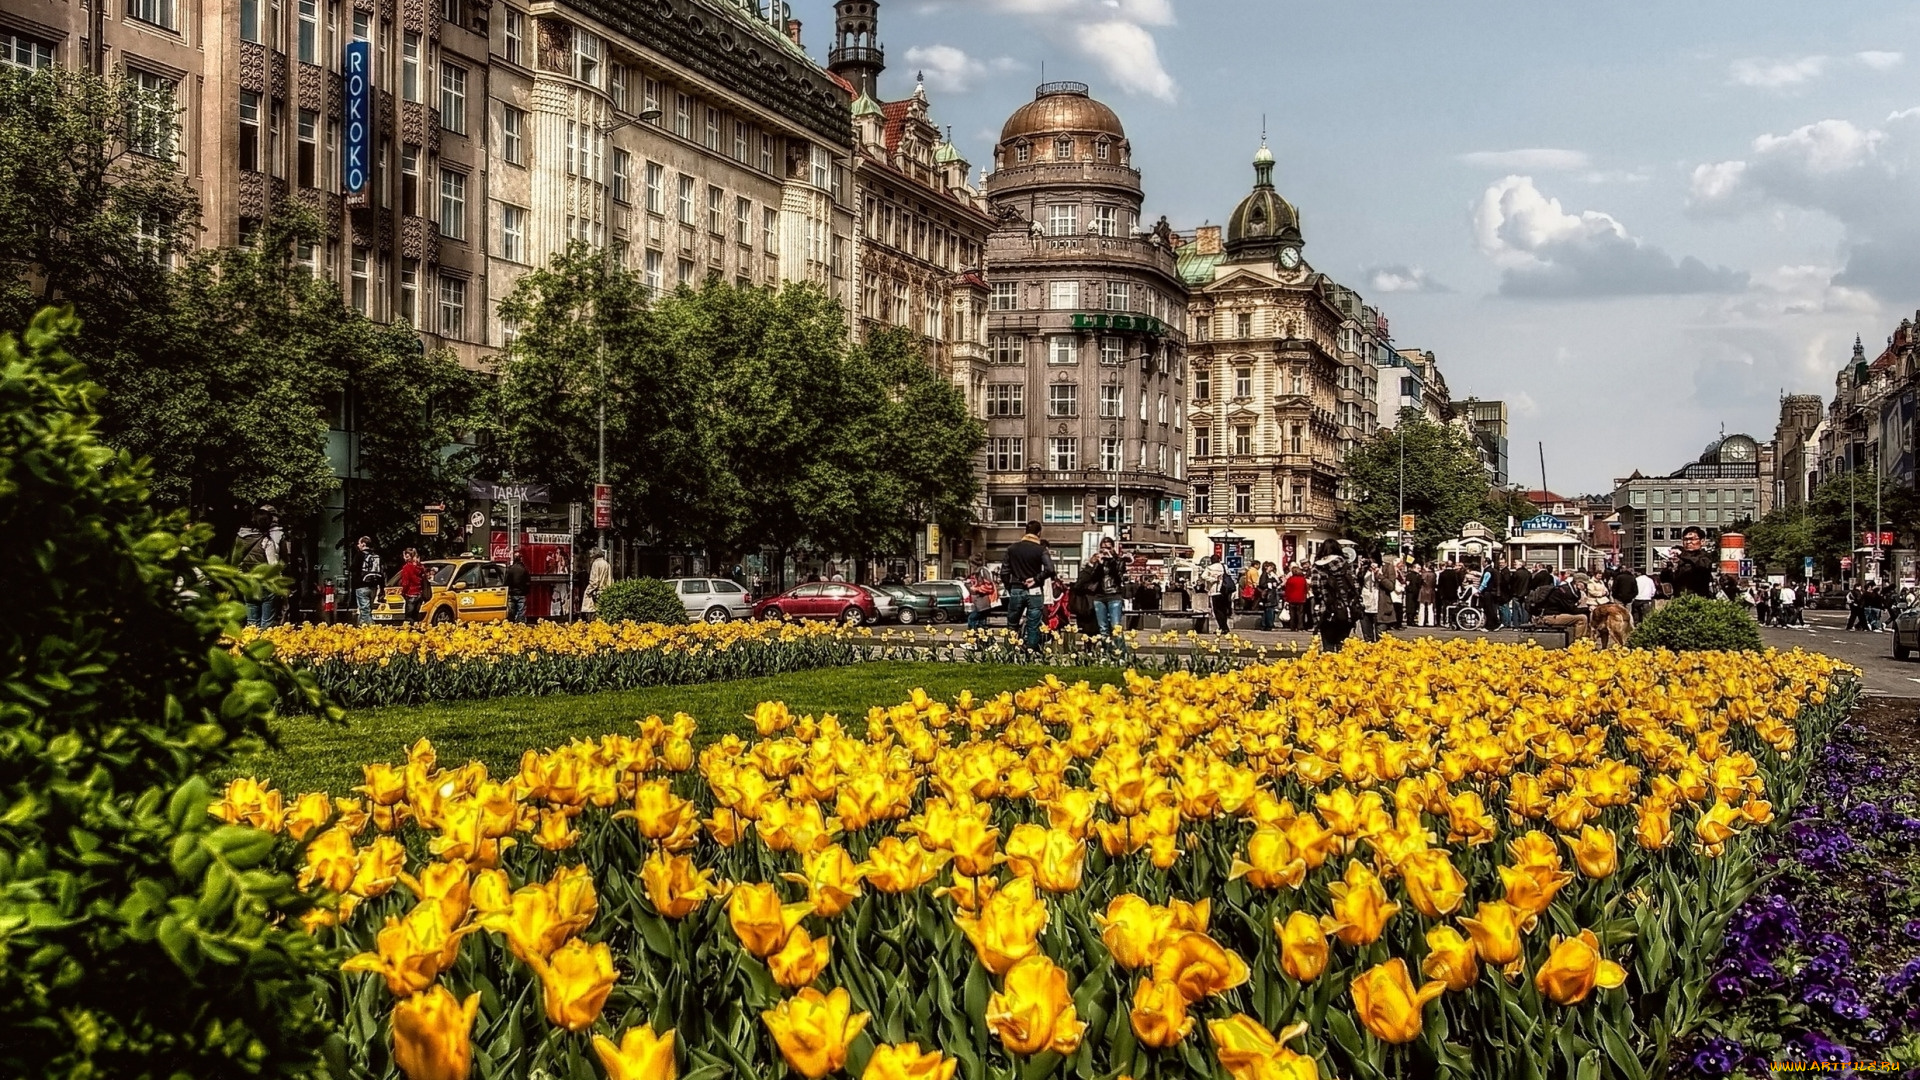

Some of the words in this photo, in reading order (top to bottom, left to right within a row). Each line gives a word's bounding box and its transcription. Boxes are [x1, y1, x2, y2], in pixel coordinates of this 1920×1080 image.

[349, 51, 363, 191] ROKOKO
[346, 193, 365, 205] hotel
[423, 519, 436, 529] TAXI
[1526, 522, 1563, 530] TRAMVAJ
[1513, 526, 1523, 537] 11
